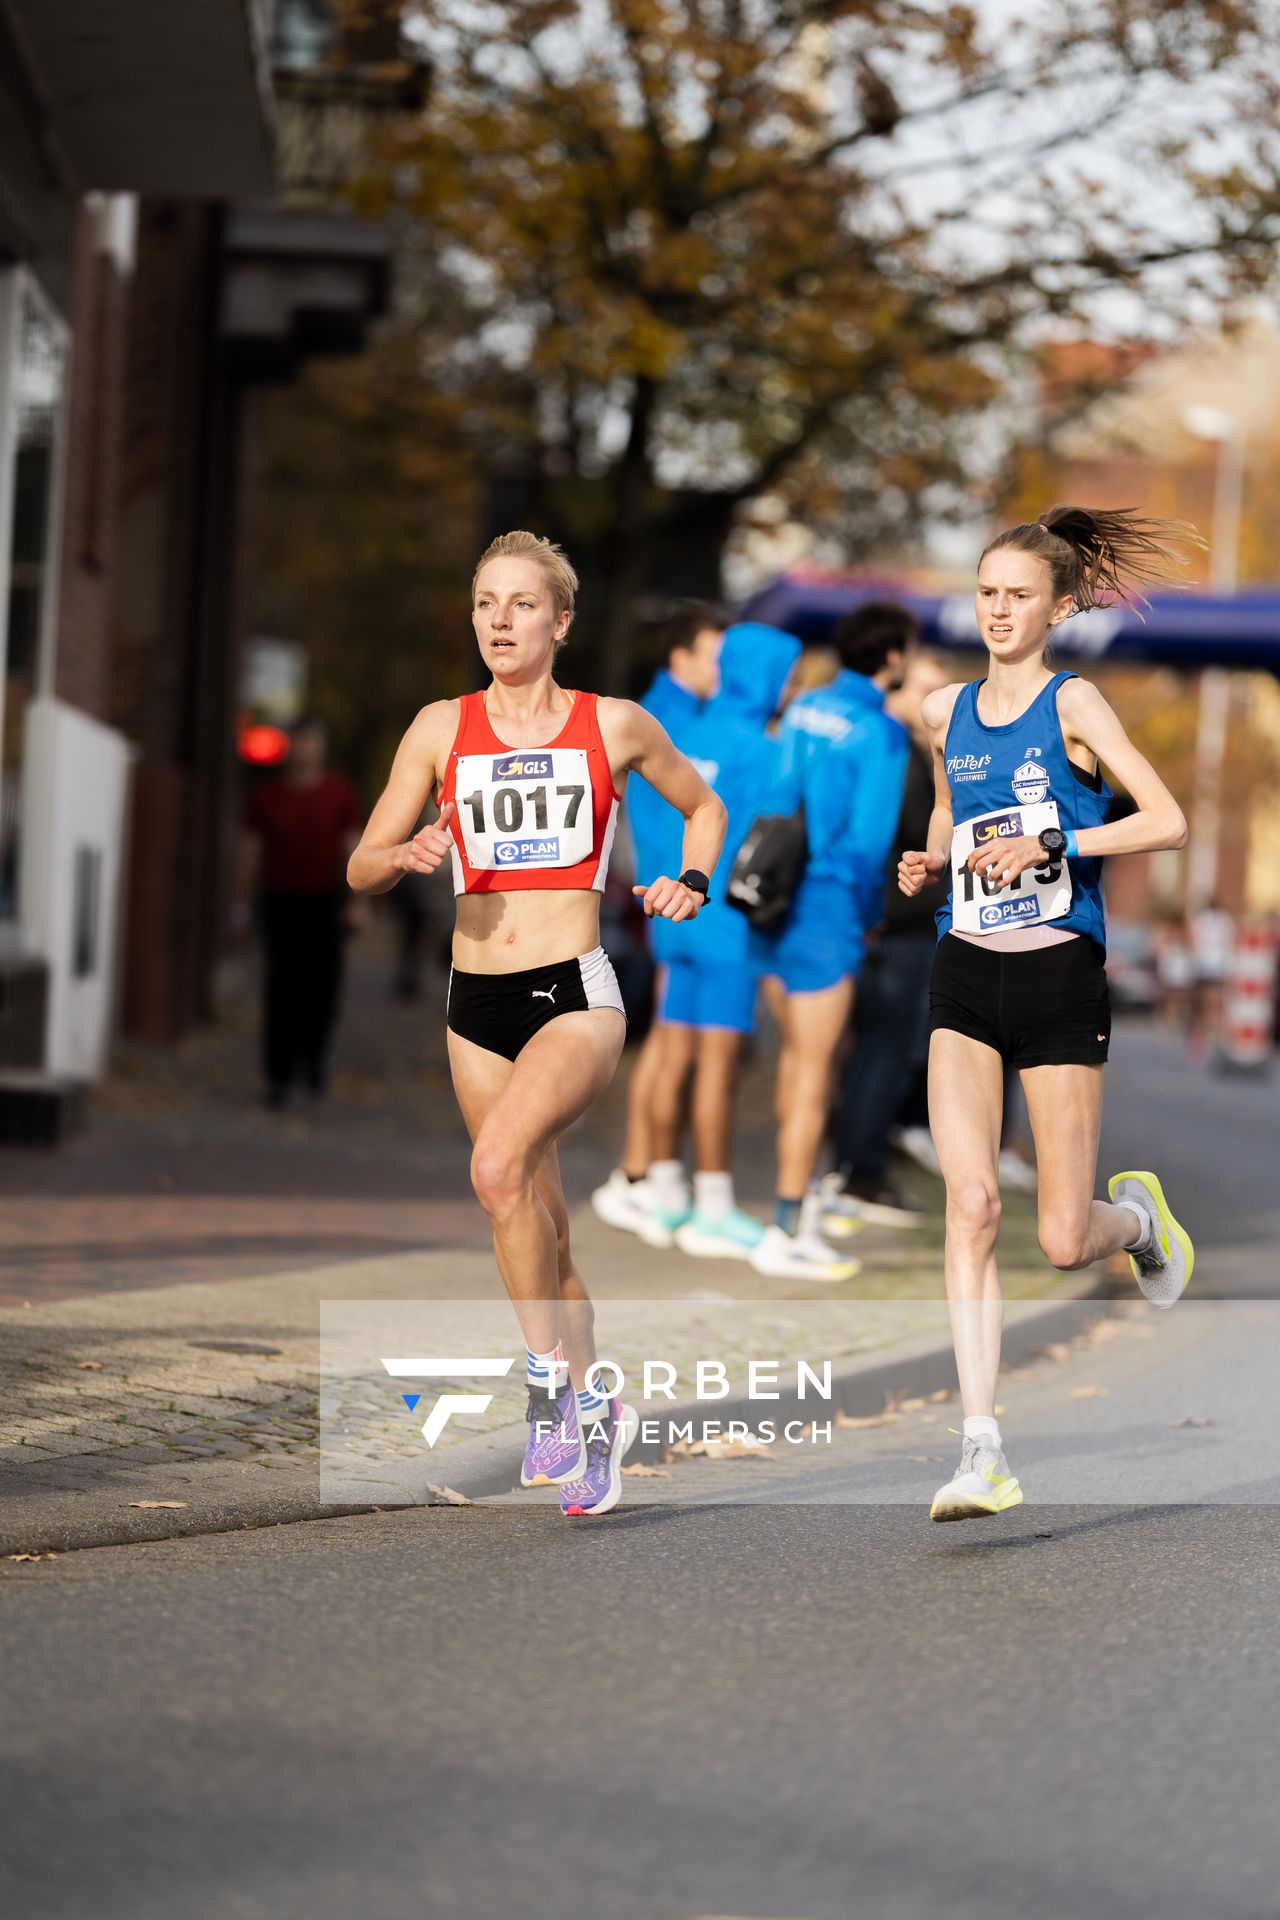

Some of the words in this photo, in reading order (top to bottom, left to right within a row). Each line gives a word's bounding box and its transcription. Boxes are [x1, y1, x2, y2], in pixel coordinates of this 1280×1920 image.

[523, 760, 548, 775] GLS
[463, 785, 586, 834] 1017
[997, 820, 1017, 836] GLS
[521, 841, 557, 854] PLAN
[1002, 899, 1037, 917] PLAN
